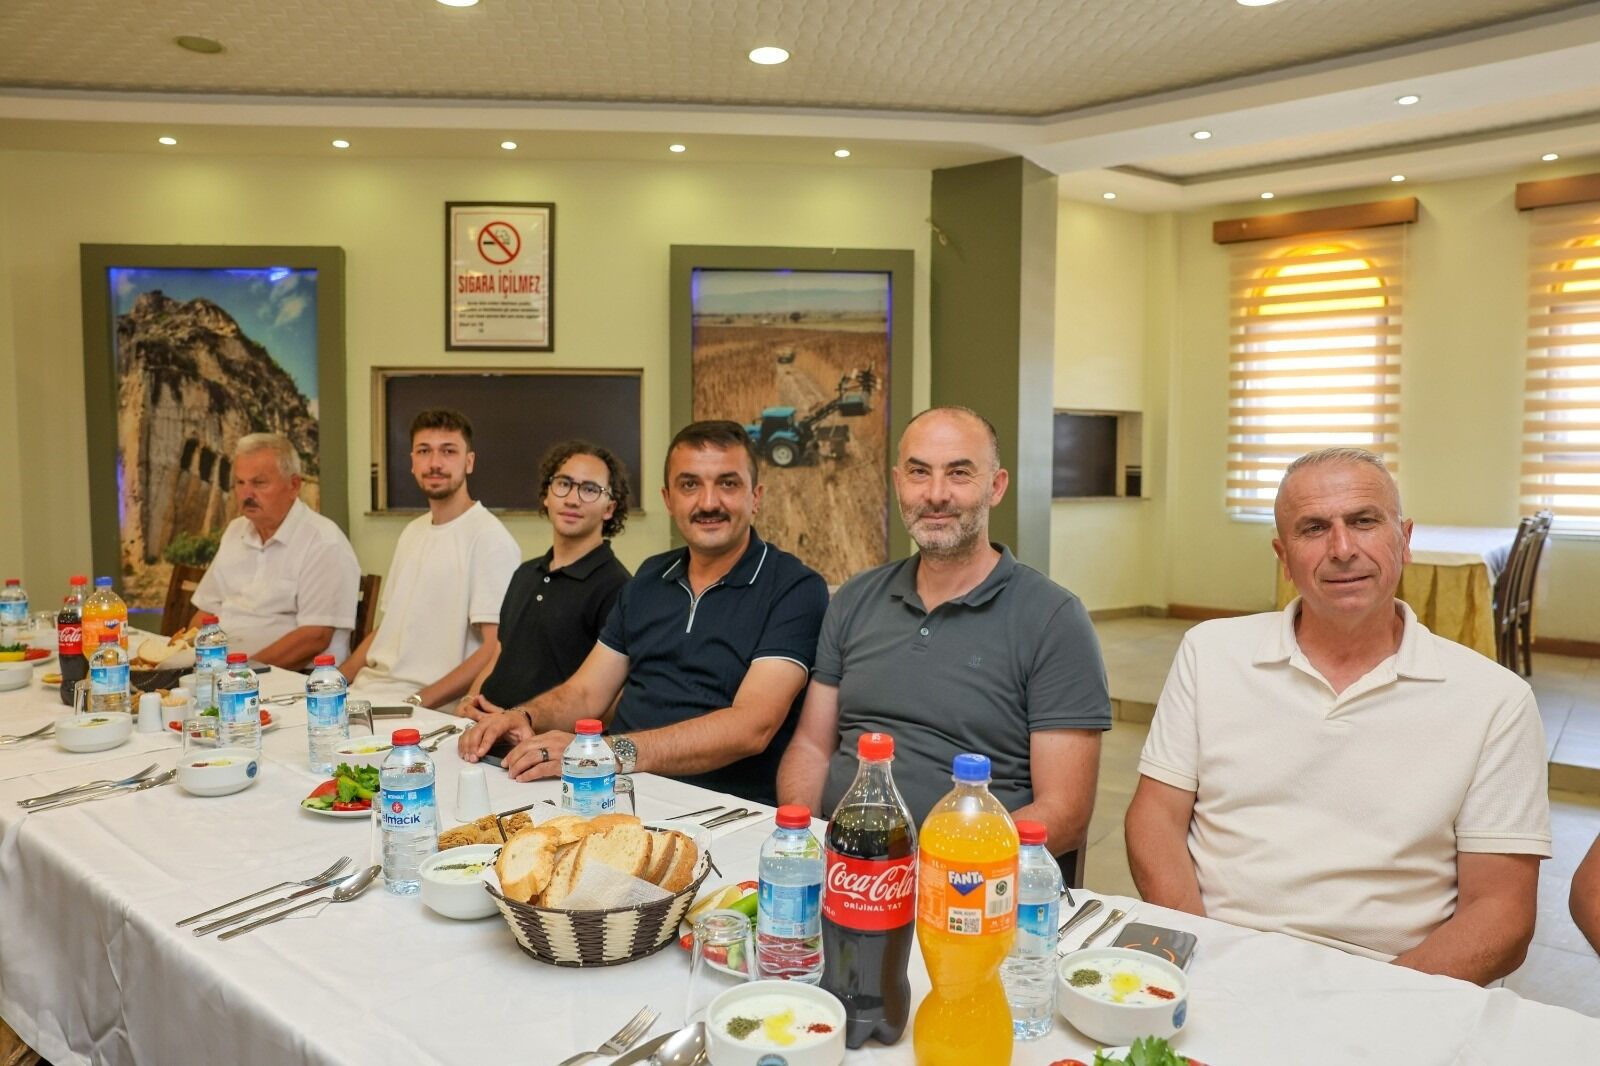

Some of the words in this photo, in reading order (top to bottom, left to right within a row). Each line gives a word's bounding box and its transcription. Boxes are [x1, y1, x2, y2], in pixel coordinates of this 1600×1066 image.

[498, 269, 541, 299] İÇİLMEZ
[828, 861, 915, 902] Coca-Cola
[947, 870, 985, 886] FANTA
[843, 901, 885, 912] ORİJİNAL
[887, 902, 902, 911] TAT
